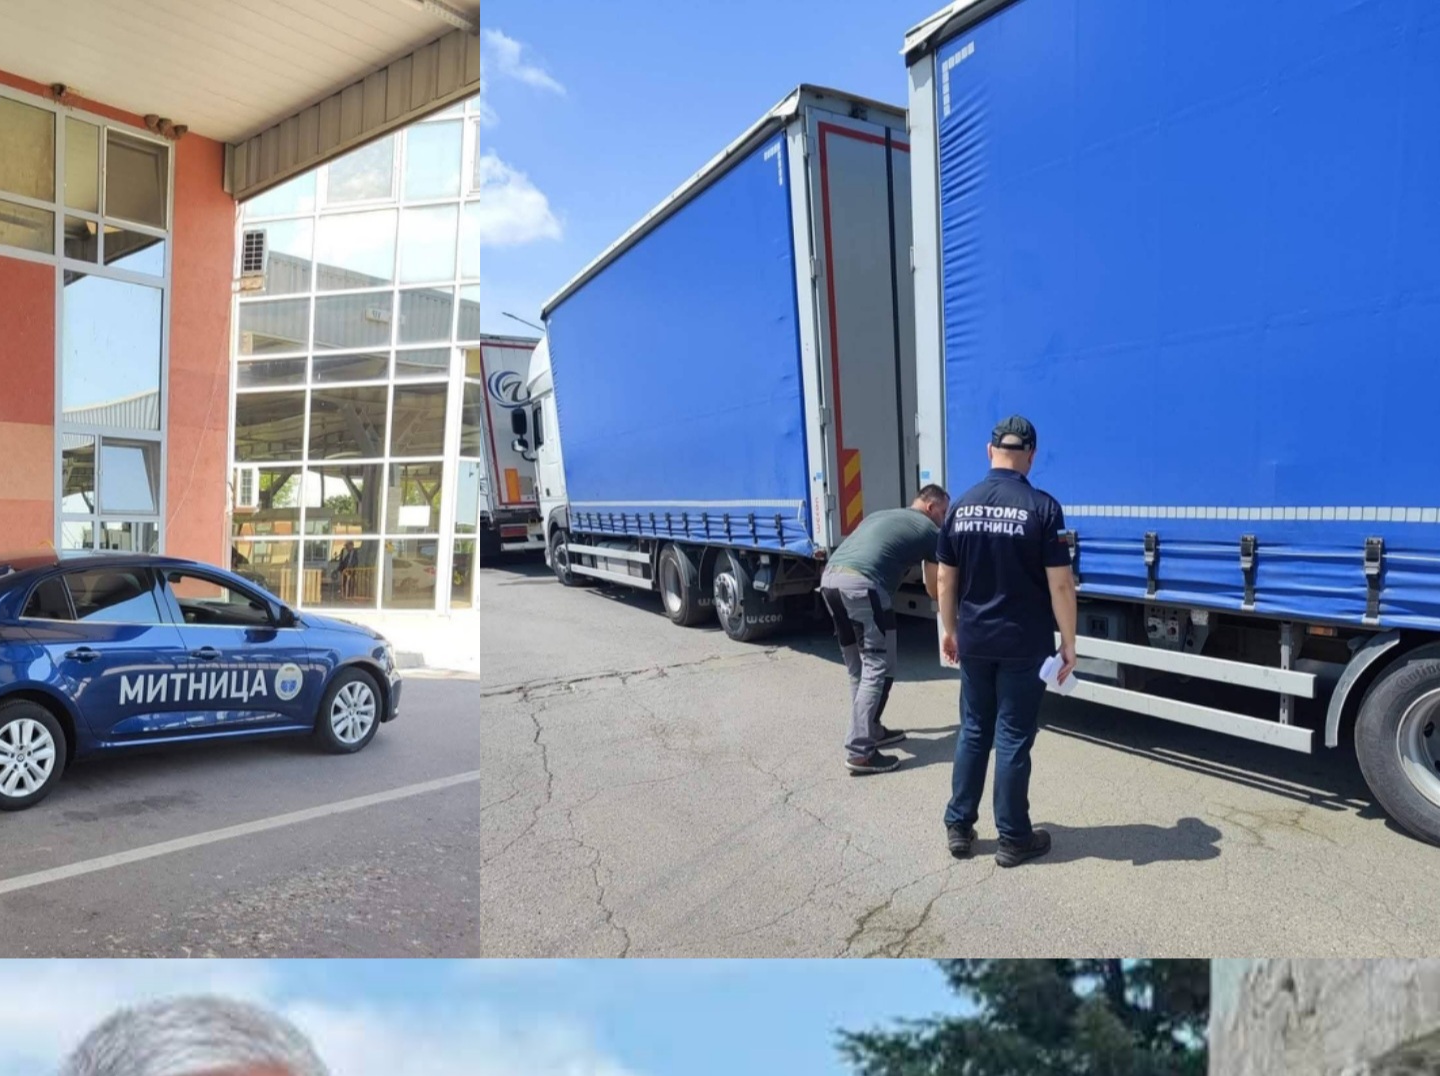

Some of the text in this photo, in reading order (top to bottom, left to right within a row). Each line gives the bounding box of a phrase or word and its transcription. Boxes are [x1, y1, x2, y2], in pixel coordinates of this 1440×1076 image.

[955, 505, 1028, 521] CUSTOMS
[954, 520, 1025, 536] МИТНИЦА
[119, 669, 268, 705] МИТНИЦА
